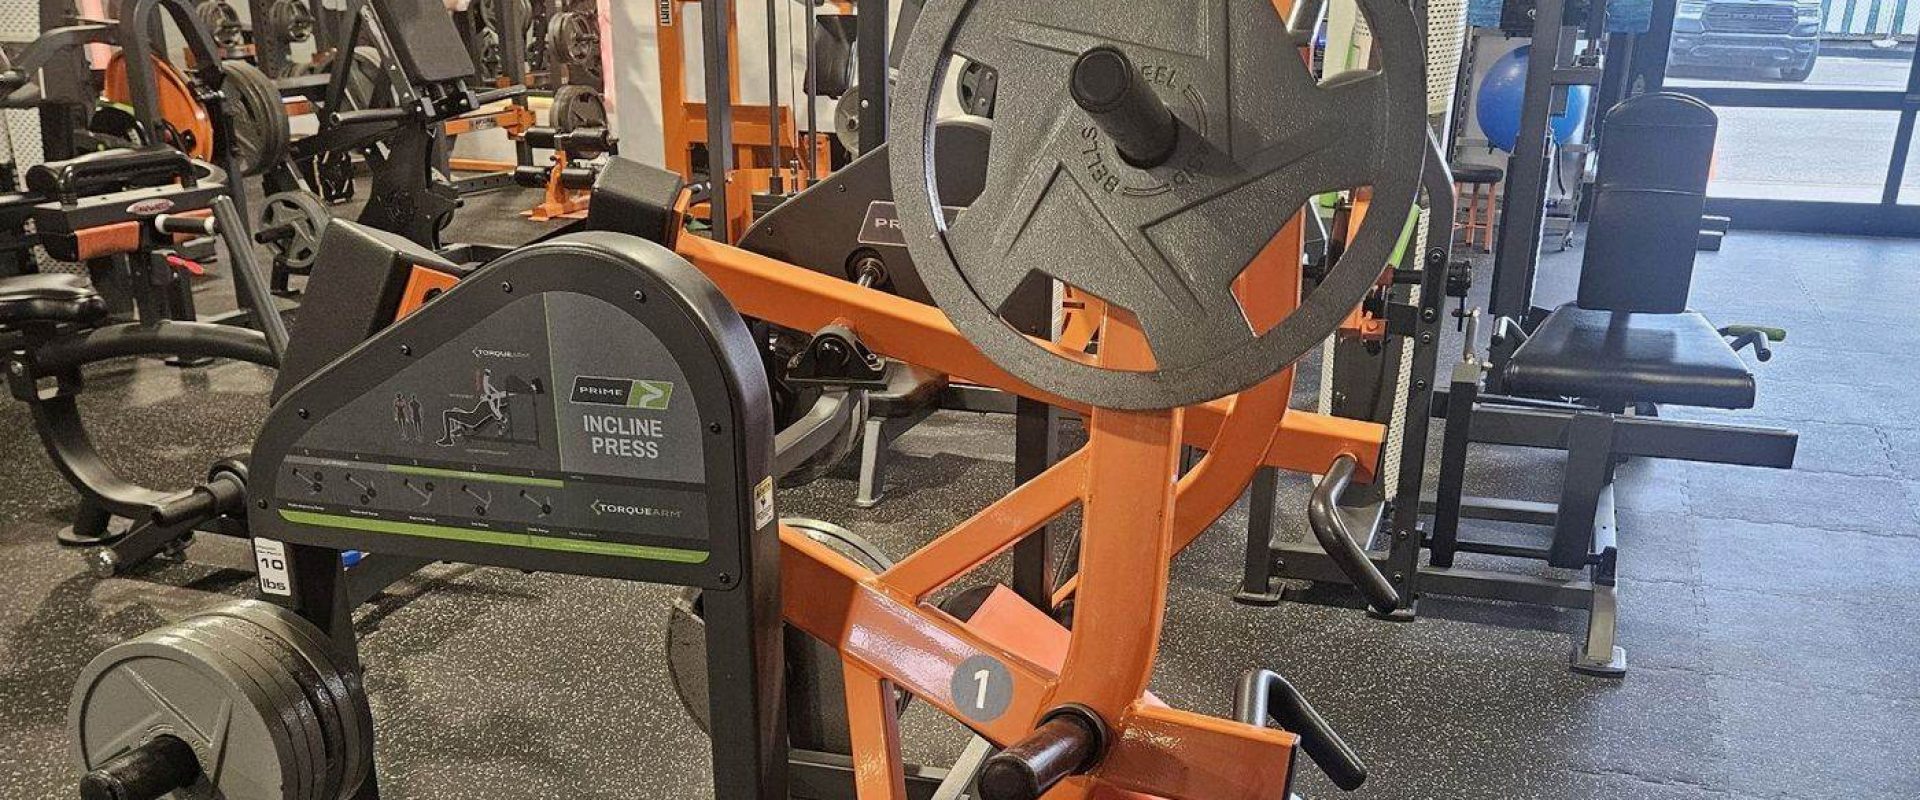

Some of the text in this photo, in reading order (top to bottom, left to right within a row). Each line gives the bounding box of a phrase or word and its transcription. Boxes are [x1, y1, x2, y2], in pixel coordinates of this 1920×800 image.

[1080, 126, 1119, 194] BELLS
[579, 386, 623, 396] PRIME
[583, 415, 663, 437] INCLINE
[591, 437, 659, 459] PRESS
[599, 504, 680, 517] TORQUEARM
[261, 558, 284, 570] 10
[262, 578, 286, 590] lbs
[974, 669, 989, 709] 1
